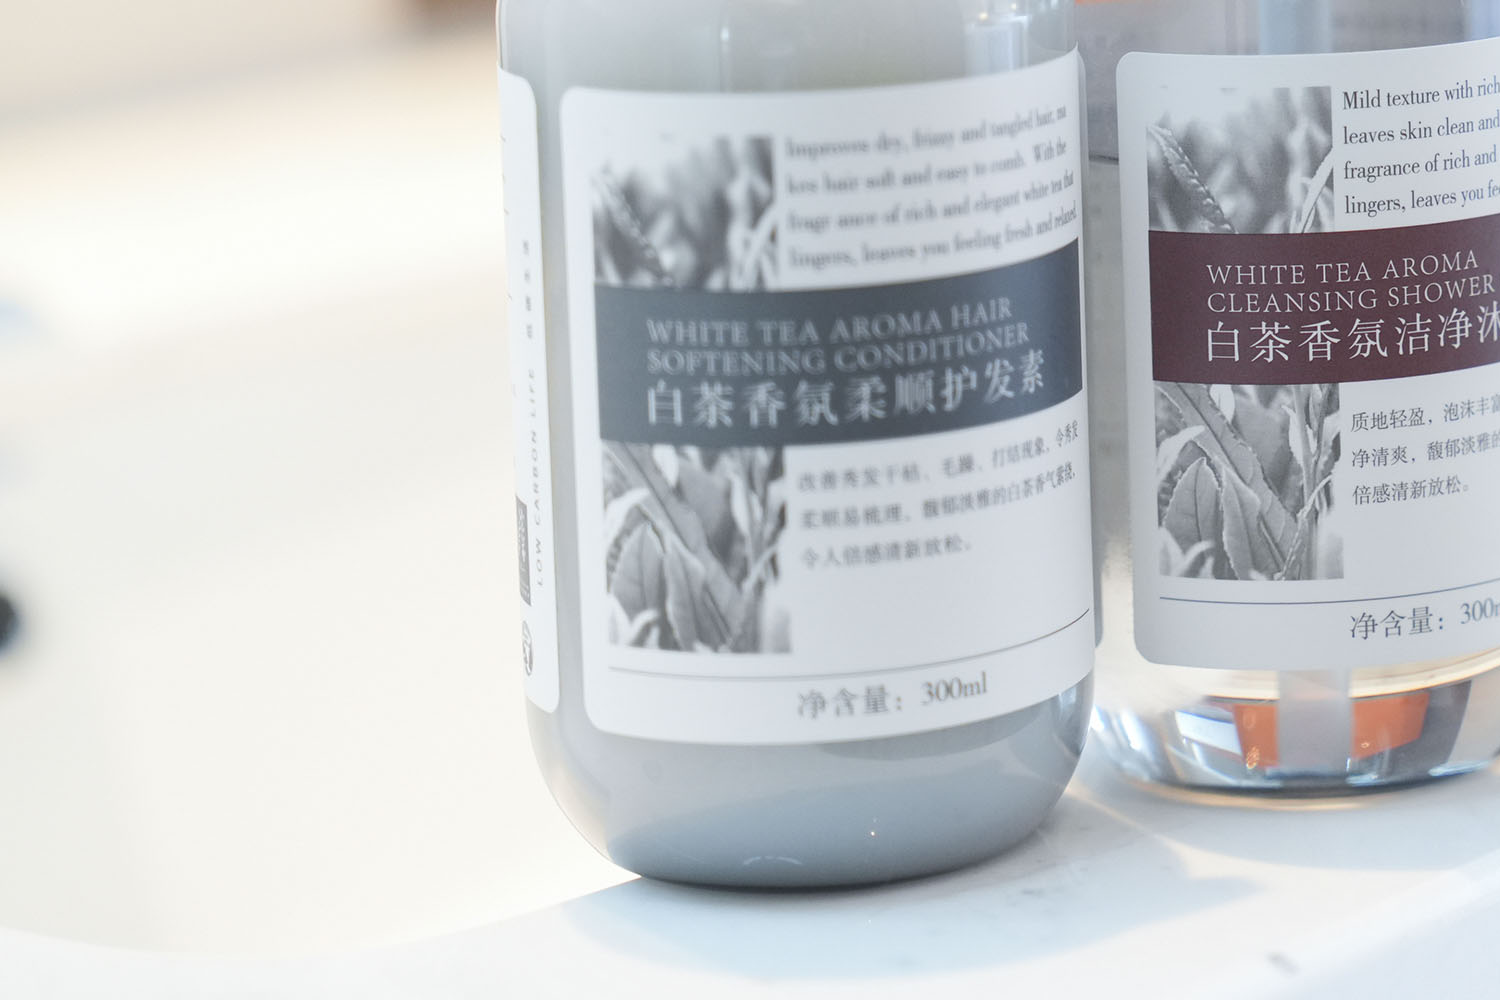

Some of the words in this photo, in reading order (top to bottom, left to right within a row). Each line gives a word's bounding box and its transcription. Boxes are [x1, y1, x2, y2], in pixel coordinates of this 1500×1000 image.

[1342, 89, 1380, 110] Mild
[1386, 88, 1440, 107] texture
[1444, 80, 1473, 101] with
[1477, 74, 1500, 96] rich
[961, 121, 986, 143] and
[991, 112, 1033, 138] tangled
[1343, 126, 1395, 145] leaves
[1399, 121, 1432, 141] skin
[1437, 117, 1474, 137] clean
[1478, 109, 1500, 131] and
[823, 170, 858, 192] hair
[866, 167, 895, 189] soft
[902, 164, 931, 185] and
[936, 165, 968, 183] easy
[974, 161, 986, 175] to
[1032, 140, 1055, 163] With
[1056, 136, 1067, 156] the
[1343, 161, 1420, 184] fragrance
[1425, 153, 1441, 172] of
[1443, 148, 1470, 170] rich
[1474, 144, 1497, 166] and
[885, 203, 902, 224] of
[905, 199, 938, 222] rich
[943, 193, 970, 217] and
[974, 190, 1022, 214] elegant
[1024, 179, 1049, 203] white
[1051, 178, 1063, 193] tea
[1063, 168, 1075, 189] that
[1345, 194, 1406, 217] lingers,
[1411, 190, 1456, 209] leaves
[1461, 186, 1484, 207] you
[861, 241, 916, 263] leaves
[922, 241, 949, 261] you
[953, 230, 1002, 253] feeling
[1005, 217, 1033, 243] fresh
[1036, 210, 1053, 235] and
[1206, 263, 1306, 285] WHITE
[1316, 261, 1372, 283] TEA
[1382, 249, 1479, 280] AROMA
[1207, 289, 1377, 314] CLEANSING
[1387, 273, 1495, 308] SHOWER
[646, 319, 749, 345] WHITE
[760, 319, 819, 344] TEA
[830, 309, 943, 343] AROMA
[951, 297, 1012, 329] HAIR
[647, 349, 826, 375] SOFTENING
[834, 322, 1029, 373] CONDITIONER
[528, 367, 537, 419] LIFE
[647, 347, 1045, 428] 白茶香氛柔顺护发素
[531, 429, 541, 527] CARBON
[536, 538, 544, 587] LOW
[922, 671, 988, 706] 300ml
